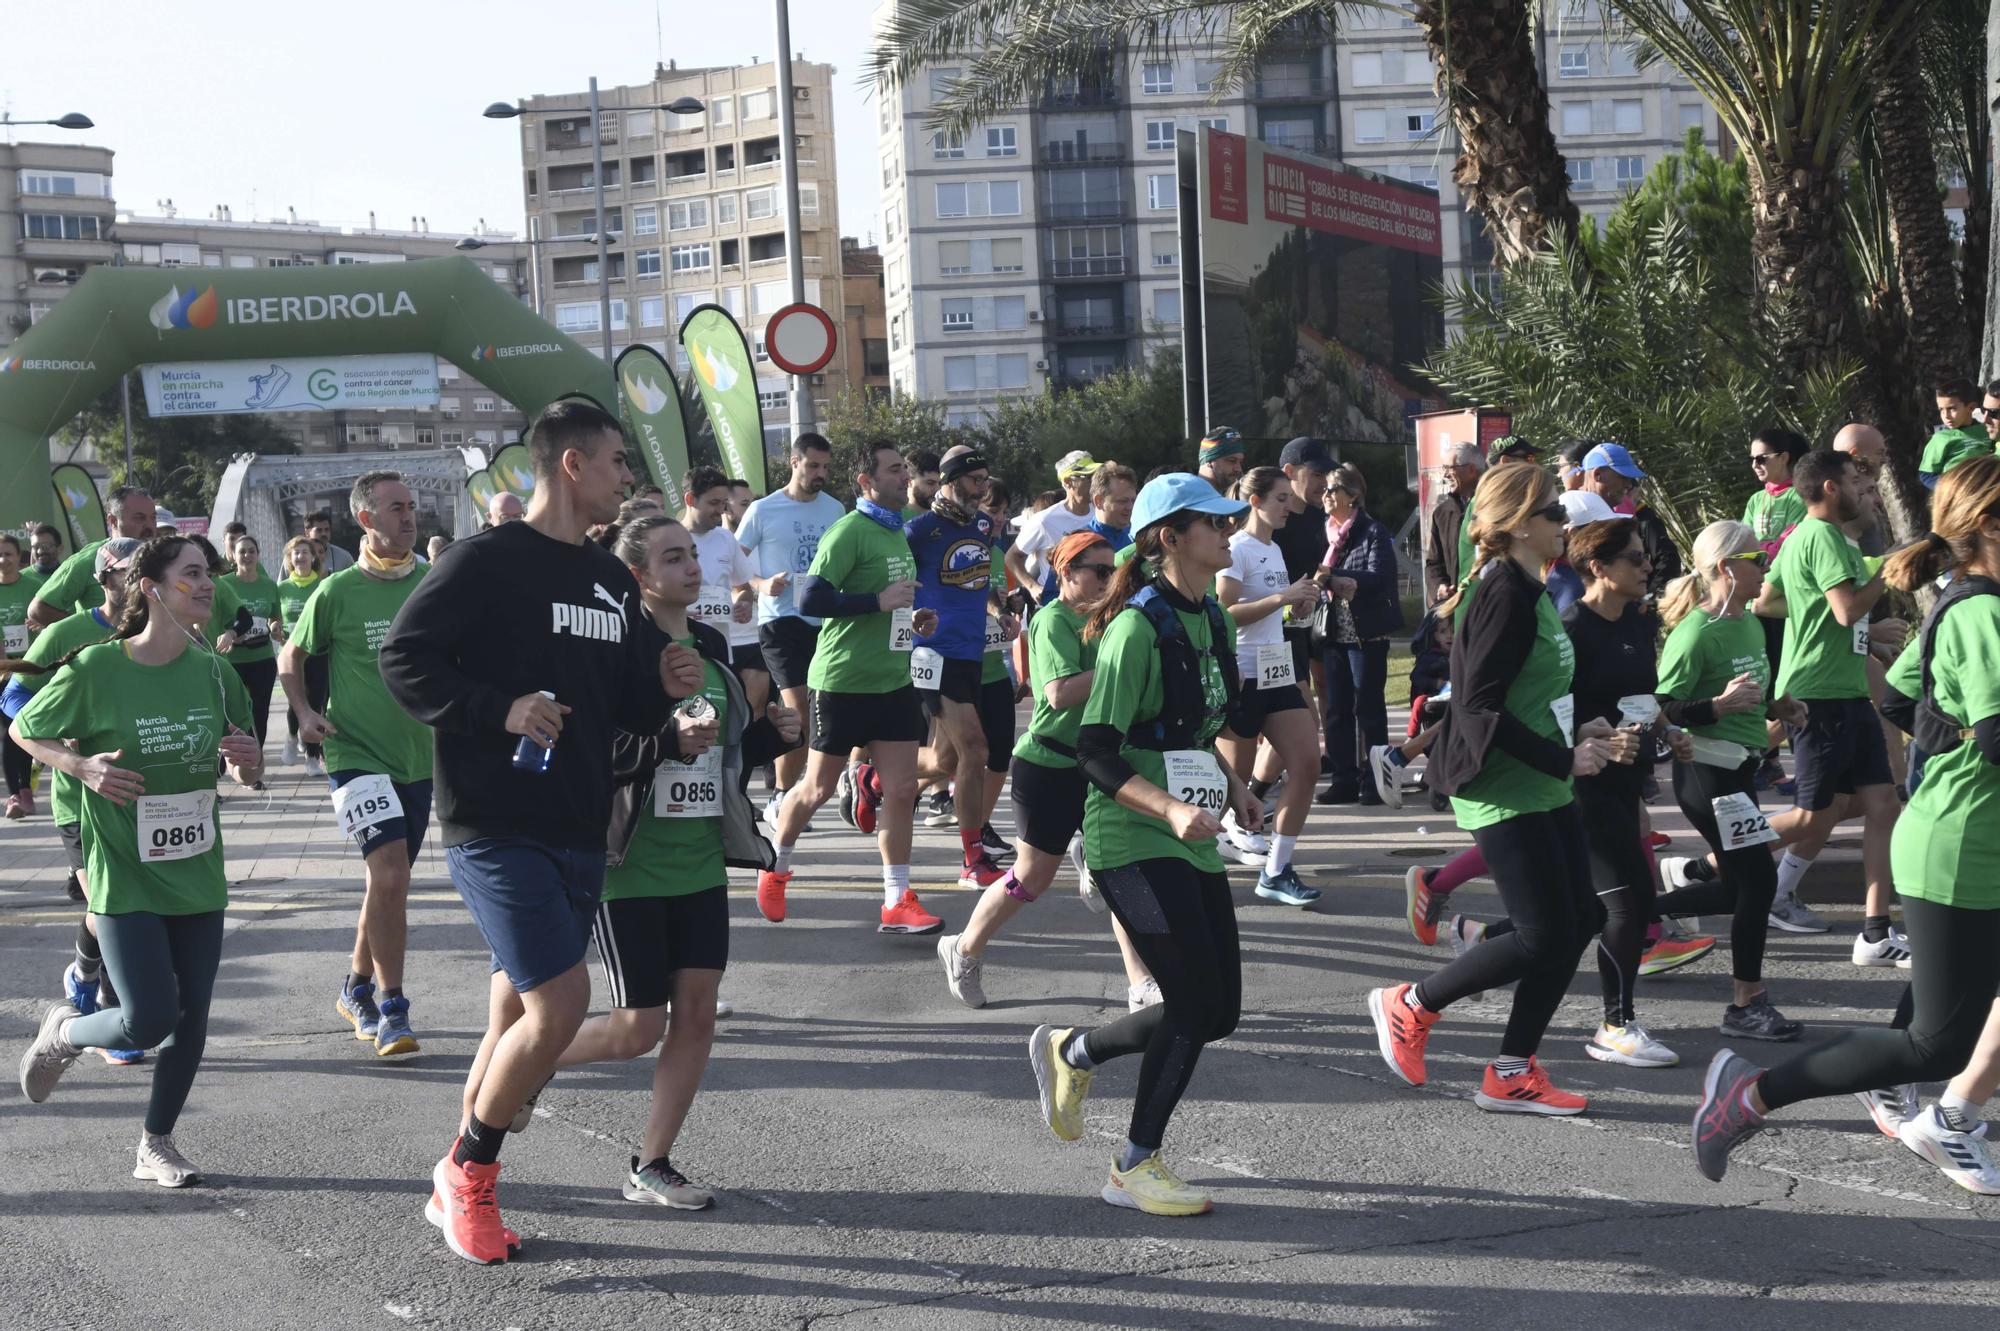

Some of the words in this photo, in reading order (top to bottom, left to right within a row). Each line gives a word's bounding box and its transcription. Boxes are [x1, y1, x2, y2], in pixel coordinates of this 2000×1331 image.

[1268, 163, 1305, 193] MURCIA
[1269, 191, 1285, 213] RIO
[1338, 190, 1348, 202] DE
[1408, 206, 1436, 224] MEJORA
[1311, 202, 1322, 217] DE
[1324, 205, 1338, 220] LOS
[1339, 206, 1379, 230] MÁRGENES
[1380, 219, 1394, 233] DEL
[226, 290, 418, 325] IBERDROLA
[496, 343, 563, 358] IBERDROLA
[22, 359, 96, 370] IBERDROLA
[343, 370, 388, 378] asociación
[391, 367, 430, 378] española
[162, 383, 177, 391] en
[180, 380, 224, 390] marcha
[344, 379, 372, 388] contra
[374, 379, 381, 387] el
[383, 378, 413, 387] cáncer
[163, 391, 201, 401] contra
[345, 390, 356, 398] en
[359, 389, 366, 397] la
[368, 388, 397, 399] Región
[399, 386, 410, 395] de
[164, 402, 175, 410] el
[180, 400, 217, 410] cáncer
[695, 604, 731, 615] 1269
[364, 619, 391, 628] Murcia
[552, 602, 622, 643] PUMA
[367, 634, 385, 643] cont
[897, 628, 912, 641] 20
[985, 632, 1007, 645] 238
[911, 666, 933, 681] 320
[1264, 663, 1291, 680] 1236
[135, 715, 168, 727] Murcia
[138, 728, 151, 736] en
[152, 722, 187, 733] marcha
[139, 734, 172, 746] contra
[141, 746, 152, 755] el
[153, 741, 185, 753] cáncer
[670, 781, 716, 803] 0856
[1181, 787, 1224, 810] 2209
[345, 795, 390, 824] 1195
[1730, 816, 1770, 837] 222
[152, 822, 205, 848] 0861
